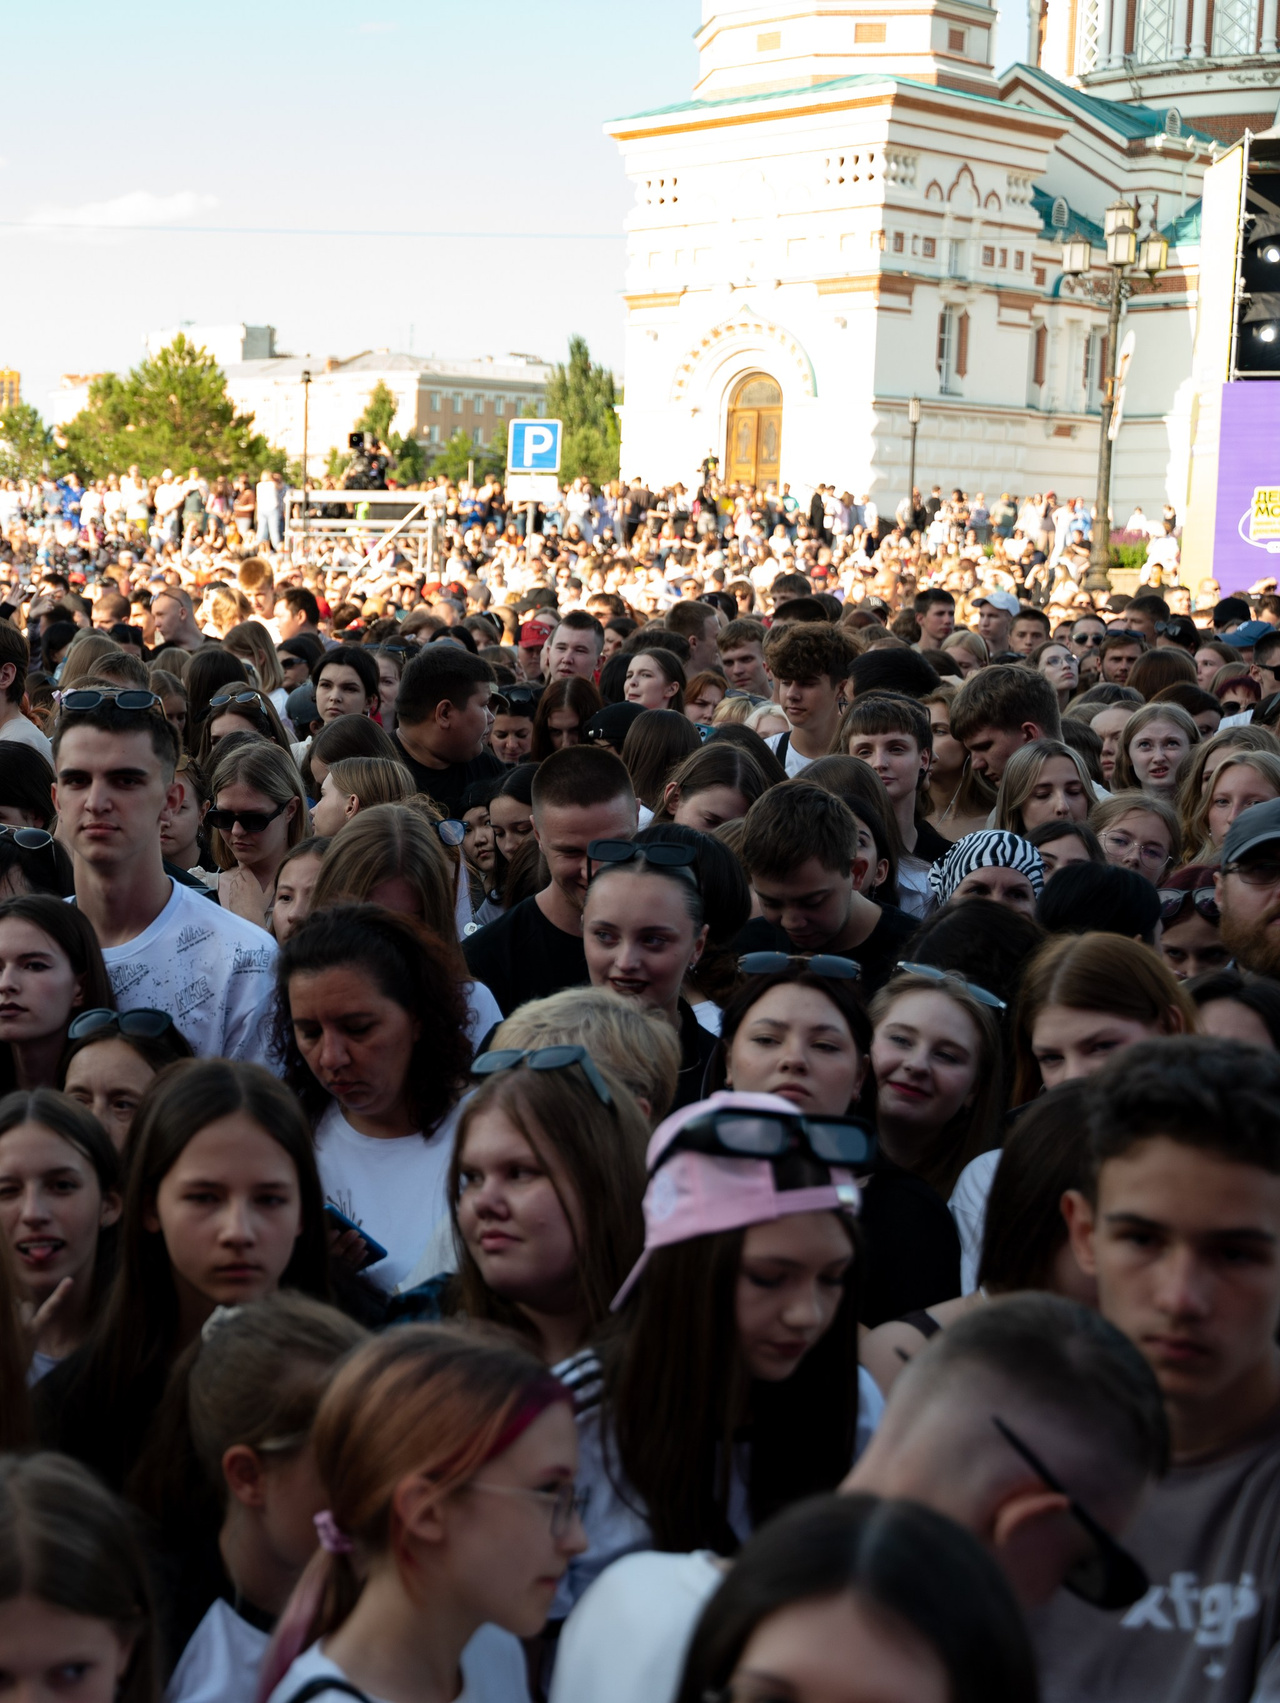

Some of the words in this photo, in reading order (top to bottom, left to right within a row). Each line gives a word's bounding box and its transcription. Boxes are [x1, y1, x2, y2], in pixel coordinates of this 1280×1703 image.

[523, 425, 553, 467] P
[1255, 491, 1280, 504] ДЕ
[232, 947, 271, 970] NIKE
[174, 975, 211, 1012] NIKE
